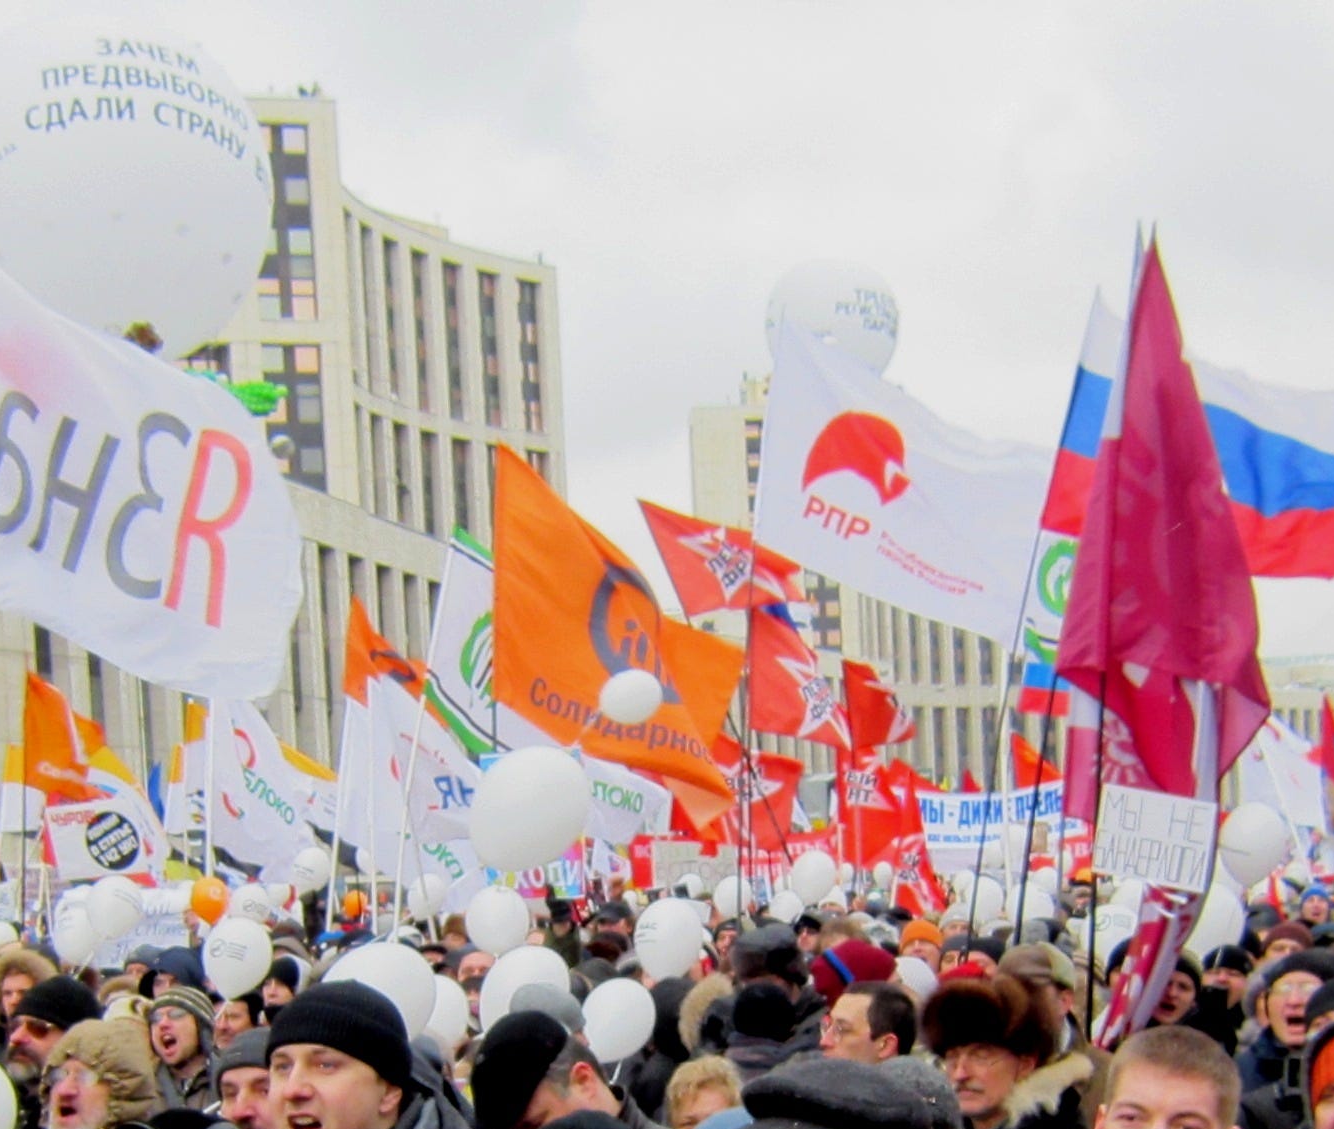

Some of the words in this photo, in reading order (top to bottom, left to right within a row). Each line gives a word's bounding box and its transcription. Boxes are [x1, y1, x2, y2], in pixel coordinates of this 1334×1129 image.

[95, 37, 201, 75] ЗАЧЕМ
[23, 96, 137, 135] СДАЛИ
[153, 101, 247, 160] СТРАНУ
[802, 495, 871, 540] РПР
[1169, 802, 1211, 845] НЕ
